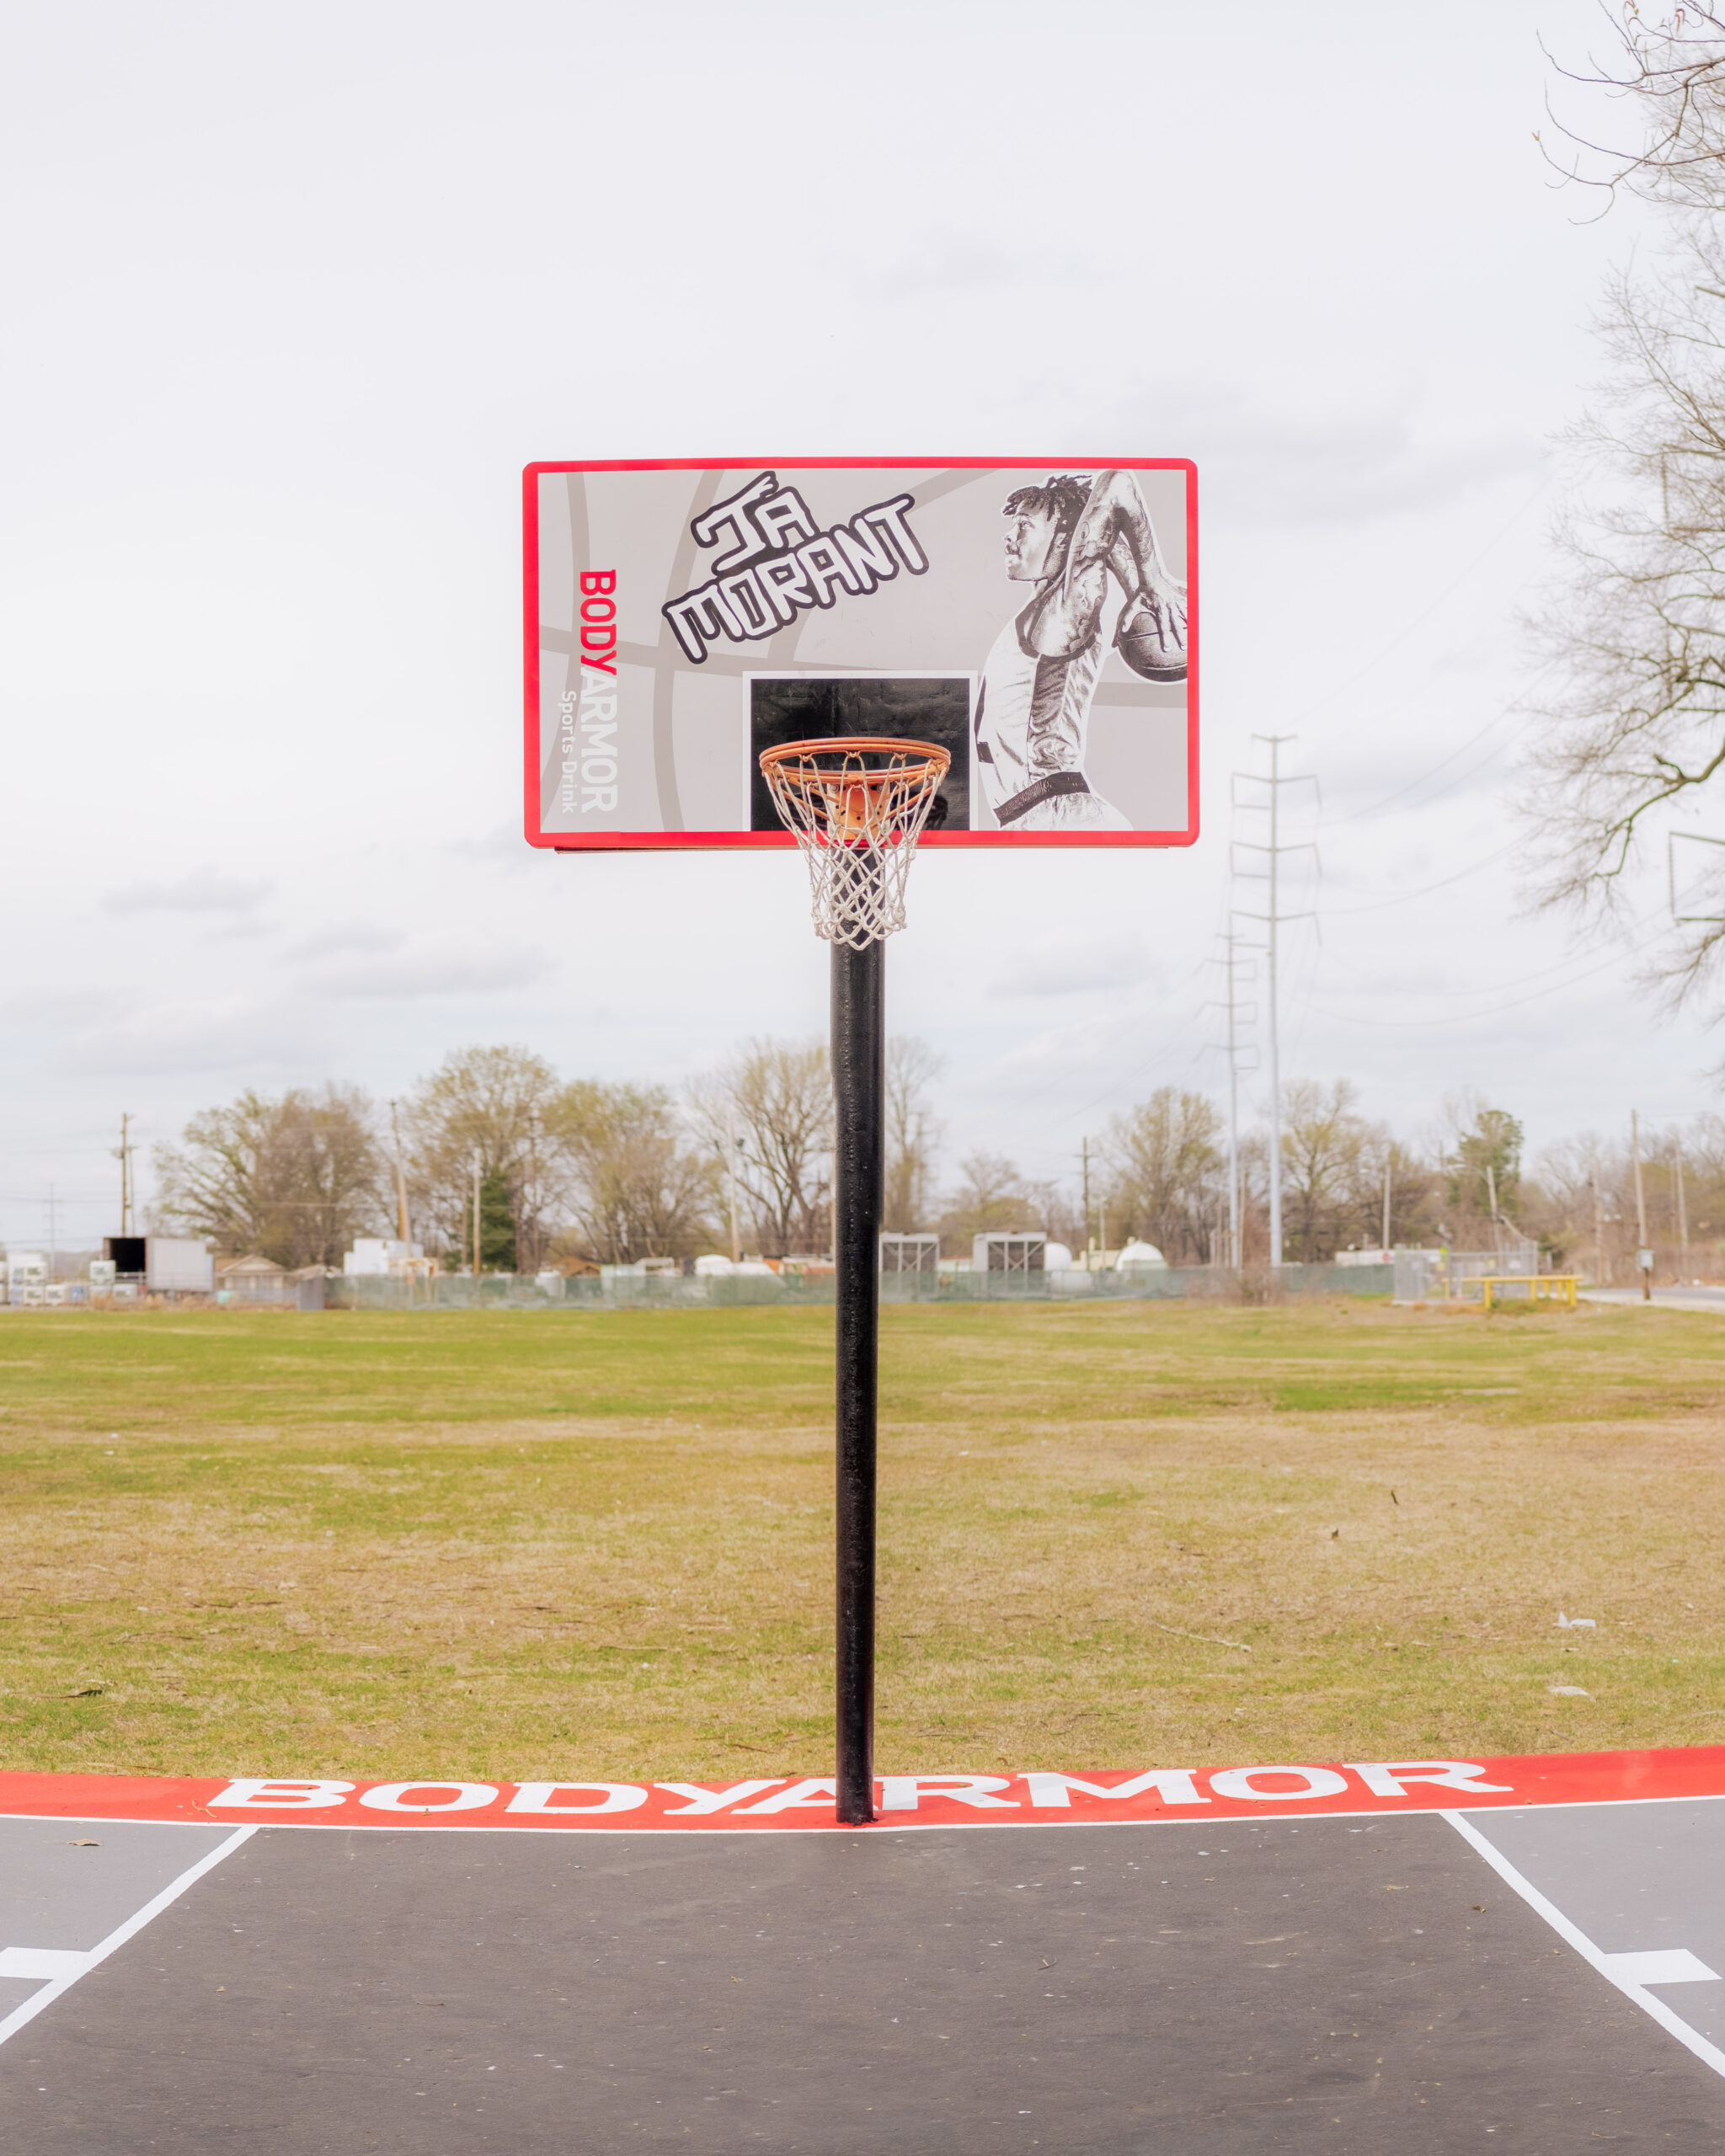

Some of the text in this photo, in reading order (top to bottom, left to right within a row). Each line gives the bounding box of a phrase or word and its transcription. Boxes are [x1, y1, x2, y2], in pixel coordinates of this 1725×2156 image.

[661, 493, 929, 664] MORANT
[691, 470, 820, 576] JA
[558, 690, 578, 814] Sports Drink
[579, 568, 618, 814] BODYARMOR
[207, 1760, 1514, 1816] BODYARMOR
